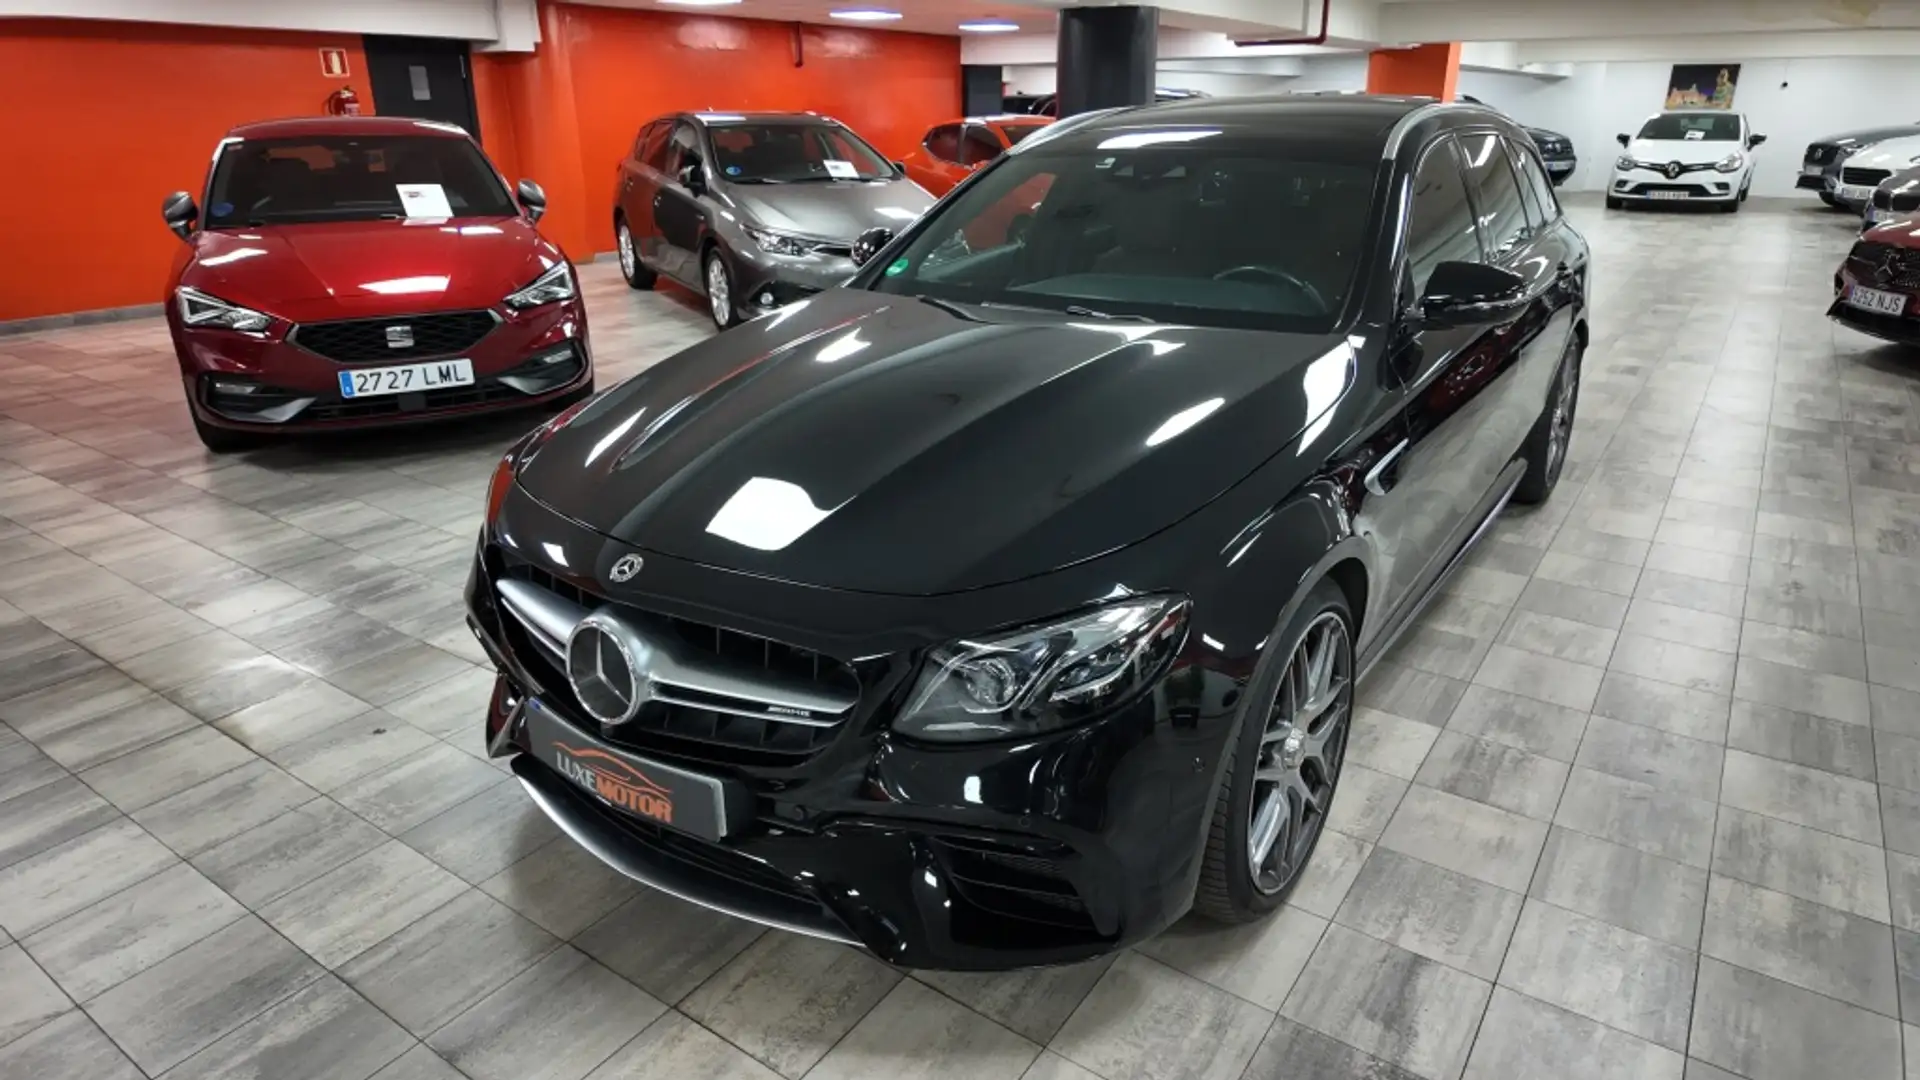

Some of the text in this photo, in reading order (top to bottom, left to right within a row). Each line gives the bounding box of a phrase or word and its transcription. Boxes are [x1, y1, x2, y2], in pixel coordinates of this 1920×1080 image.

[1877, 293, 1901, 313] NJS
[355, 363, 467, 393] 2727 LML
